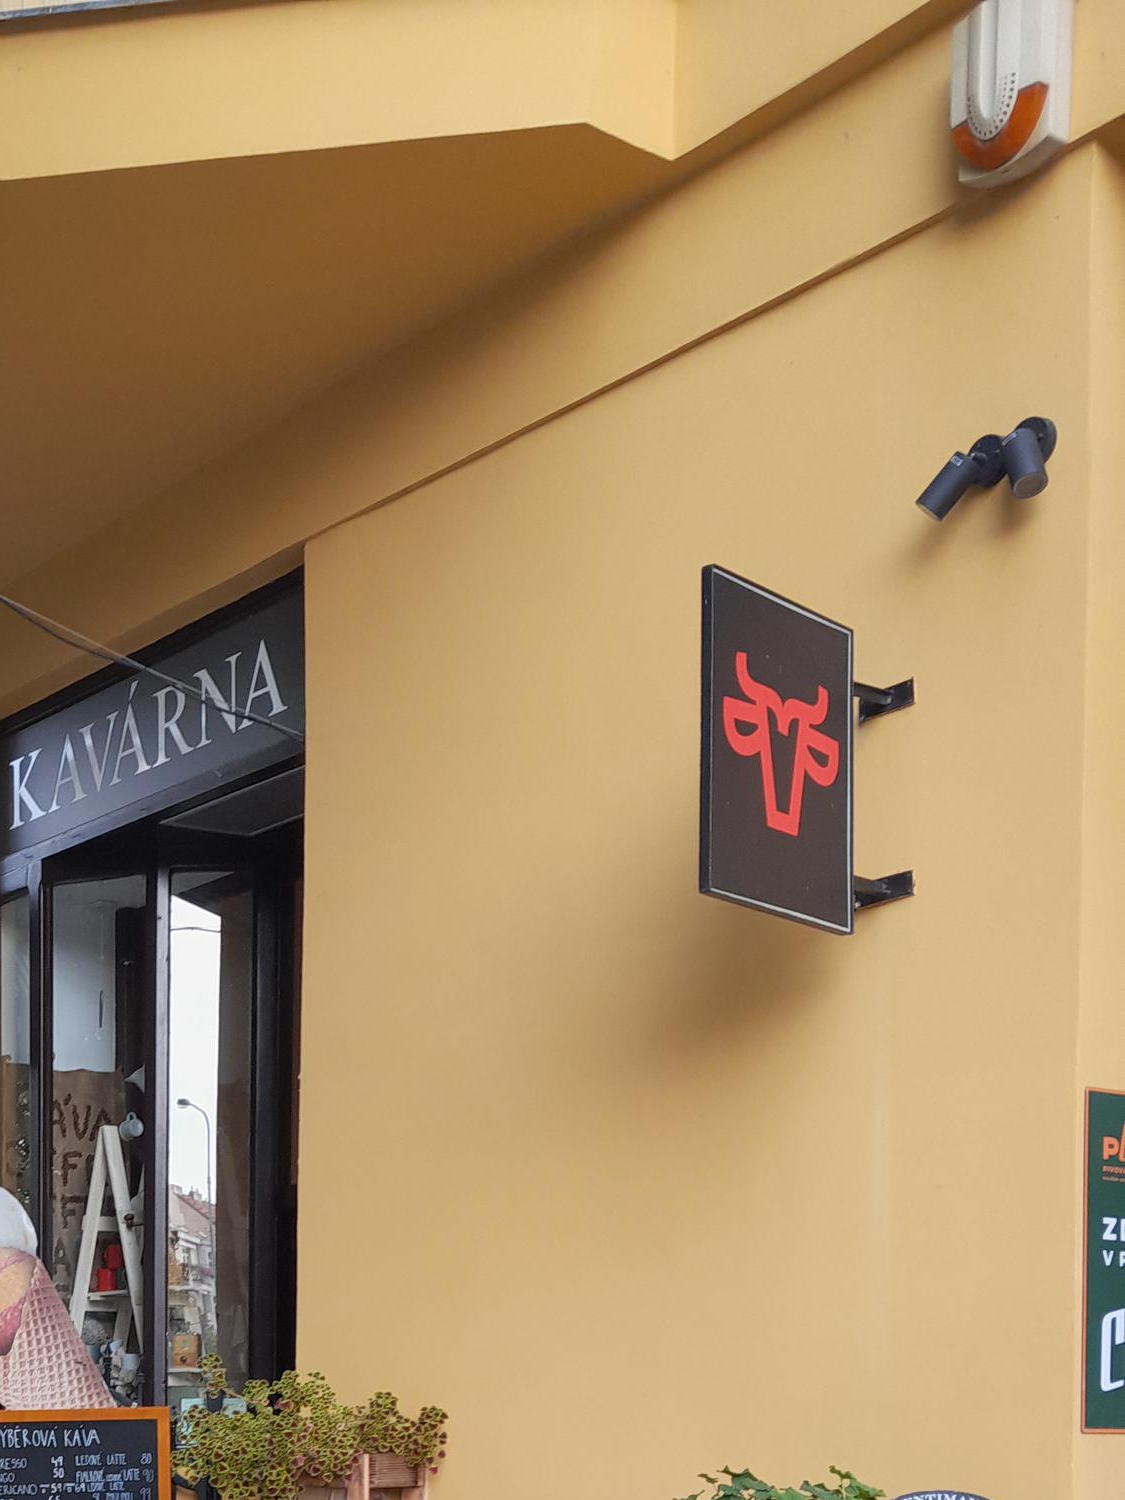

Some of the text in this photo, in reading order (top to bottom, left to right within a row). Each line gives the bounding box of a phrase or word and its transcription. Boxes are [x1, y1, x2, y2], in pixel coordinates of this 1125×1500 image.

[9, 639, 289, 831] KAVÁRNA
[64, 1424, 100, 1447] KÁVA
[51, 1455, 63, 1467] 49
[53, 1467, 65, 1478] 50
